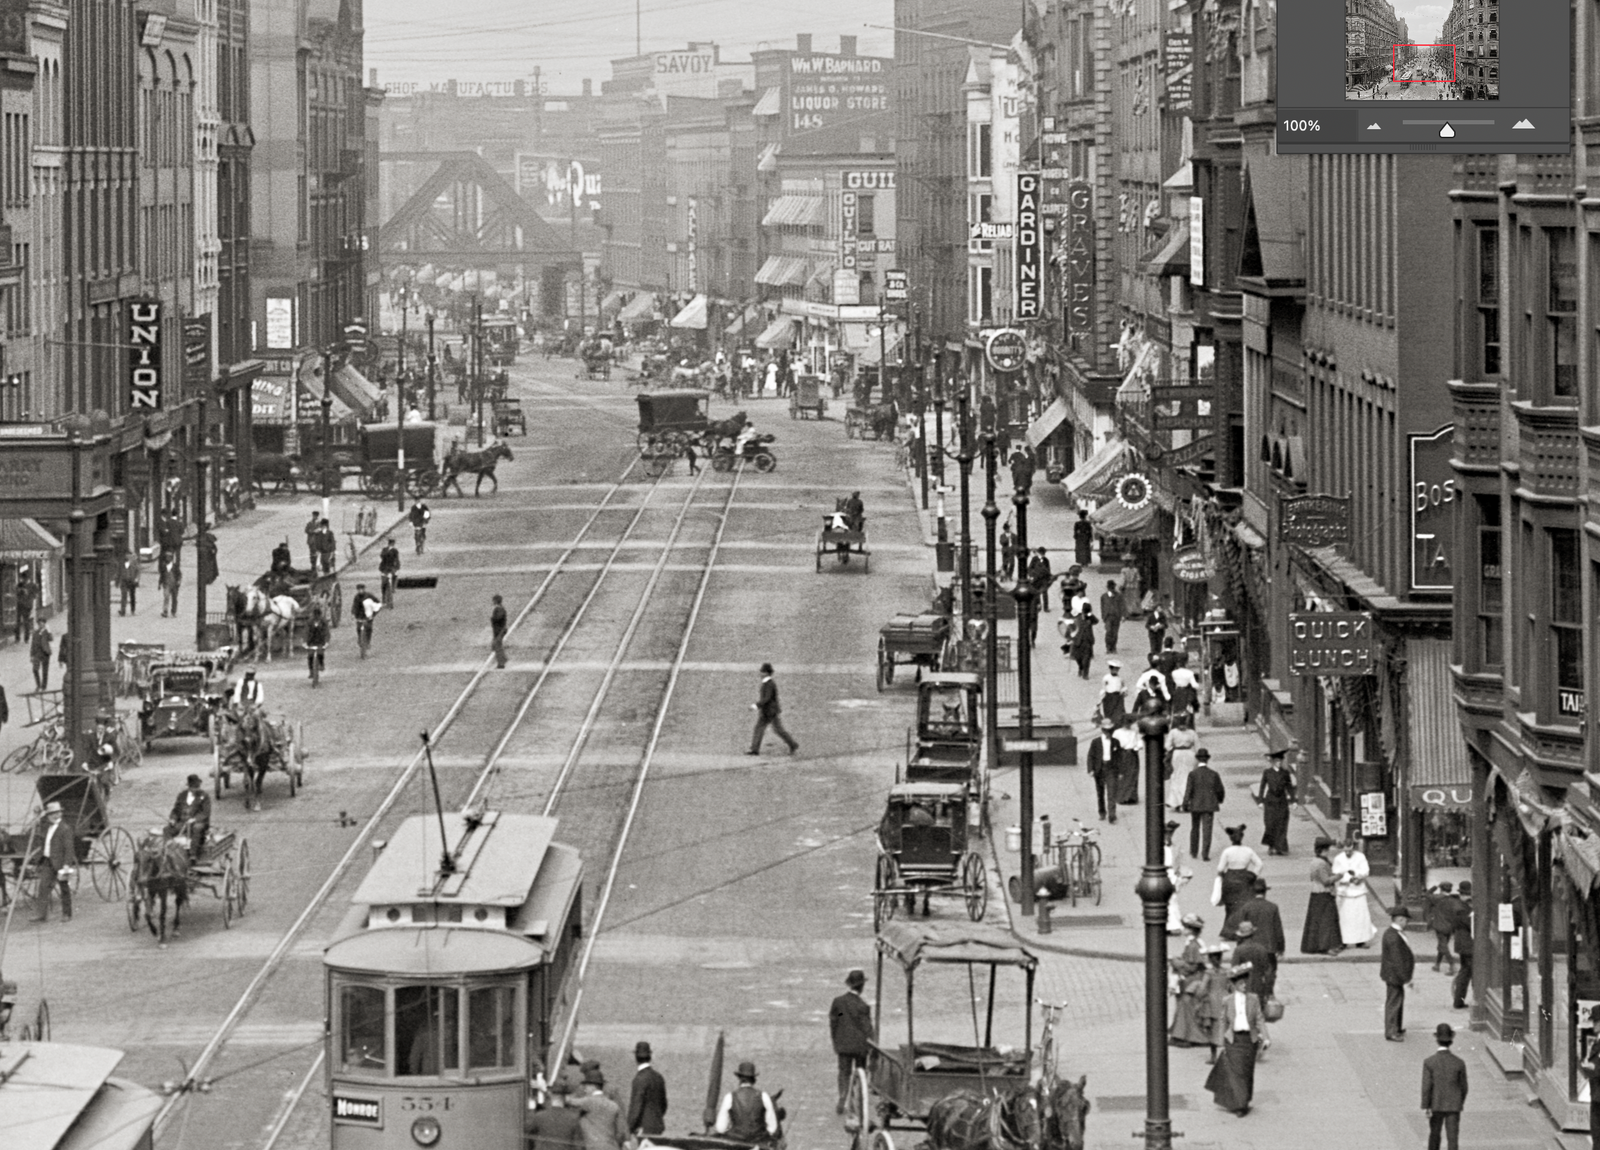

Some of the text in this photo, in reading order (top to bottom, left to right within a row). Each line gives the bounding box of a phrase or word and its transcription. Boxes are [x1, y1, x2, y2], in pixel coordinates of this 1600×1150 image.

[793, 96, 839, 110] LIQUOR
[794, 114, 823, 129] 148
[859, 240, 875, 251] CUT
[1020, 177, 1036, 316] GARDINER
[1070, 190, 1090, 326] GRAVES
[131, 304, 158, 408] UNION
[1295, 621, 1366, 639] QUICK
[1293, 649, 1369, 667] LUNCH
[1422, 789, 1473, 806] QU
